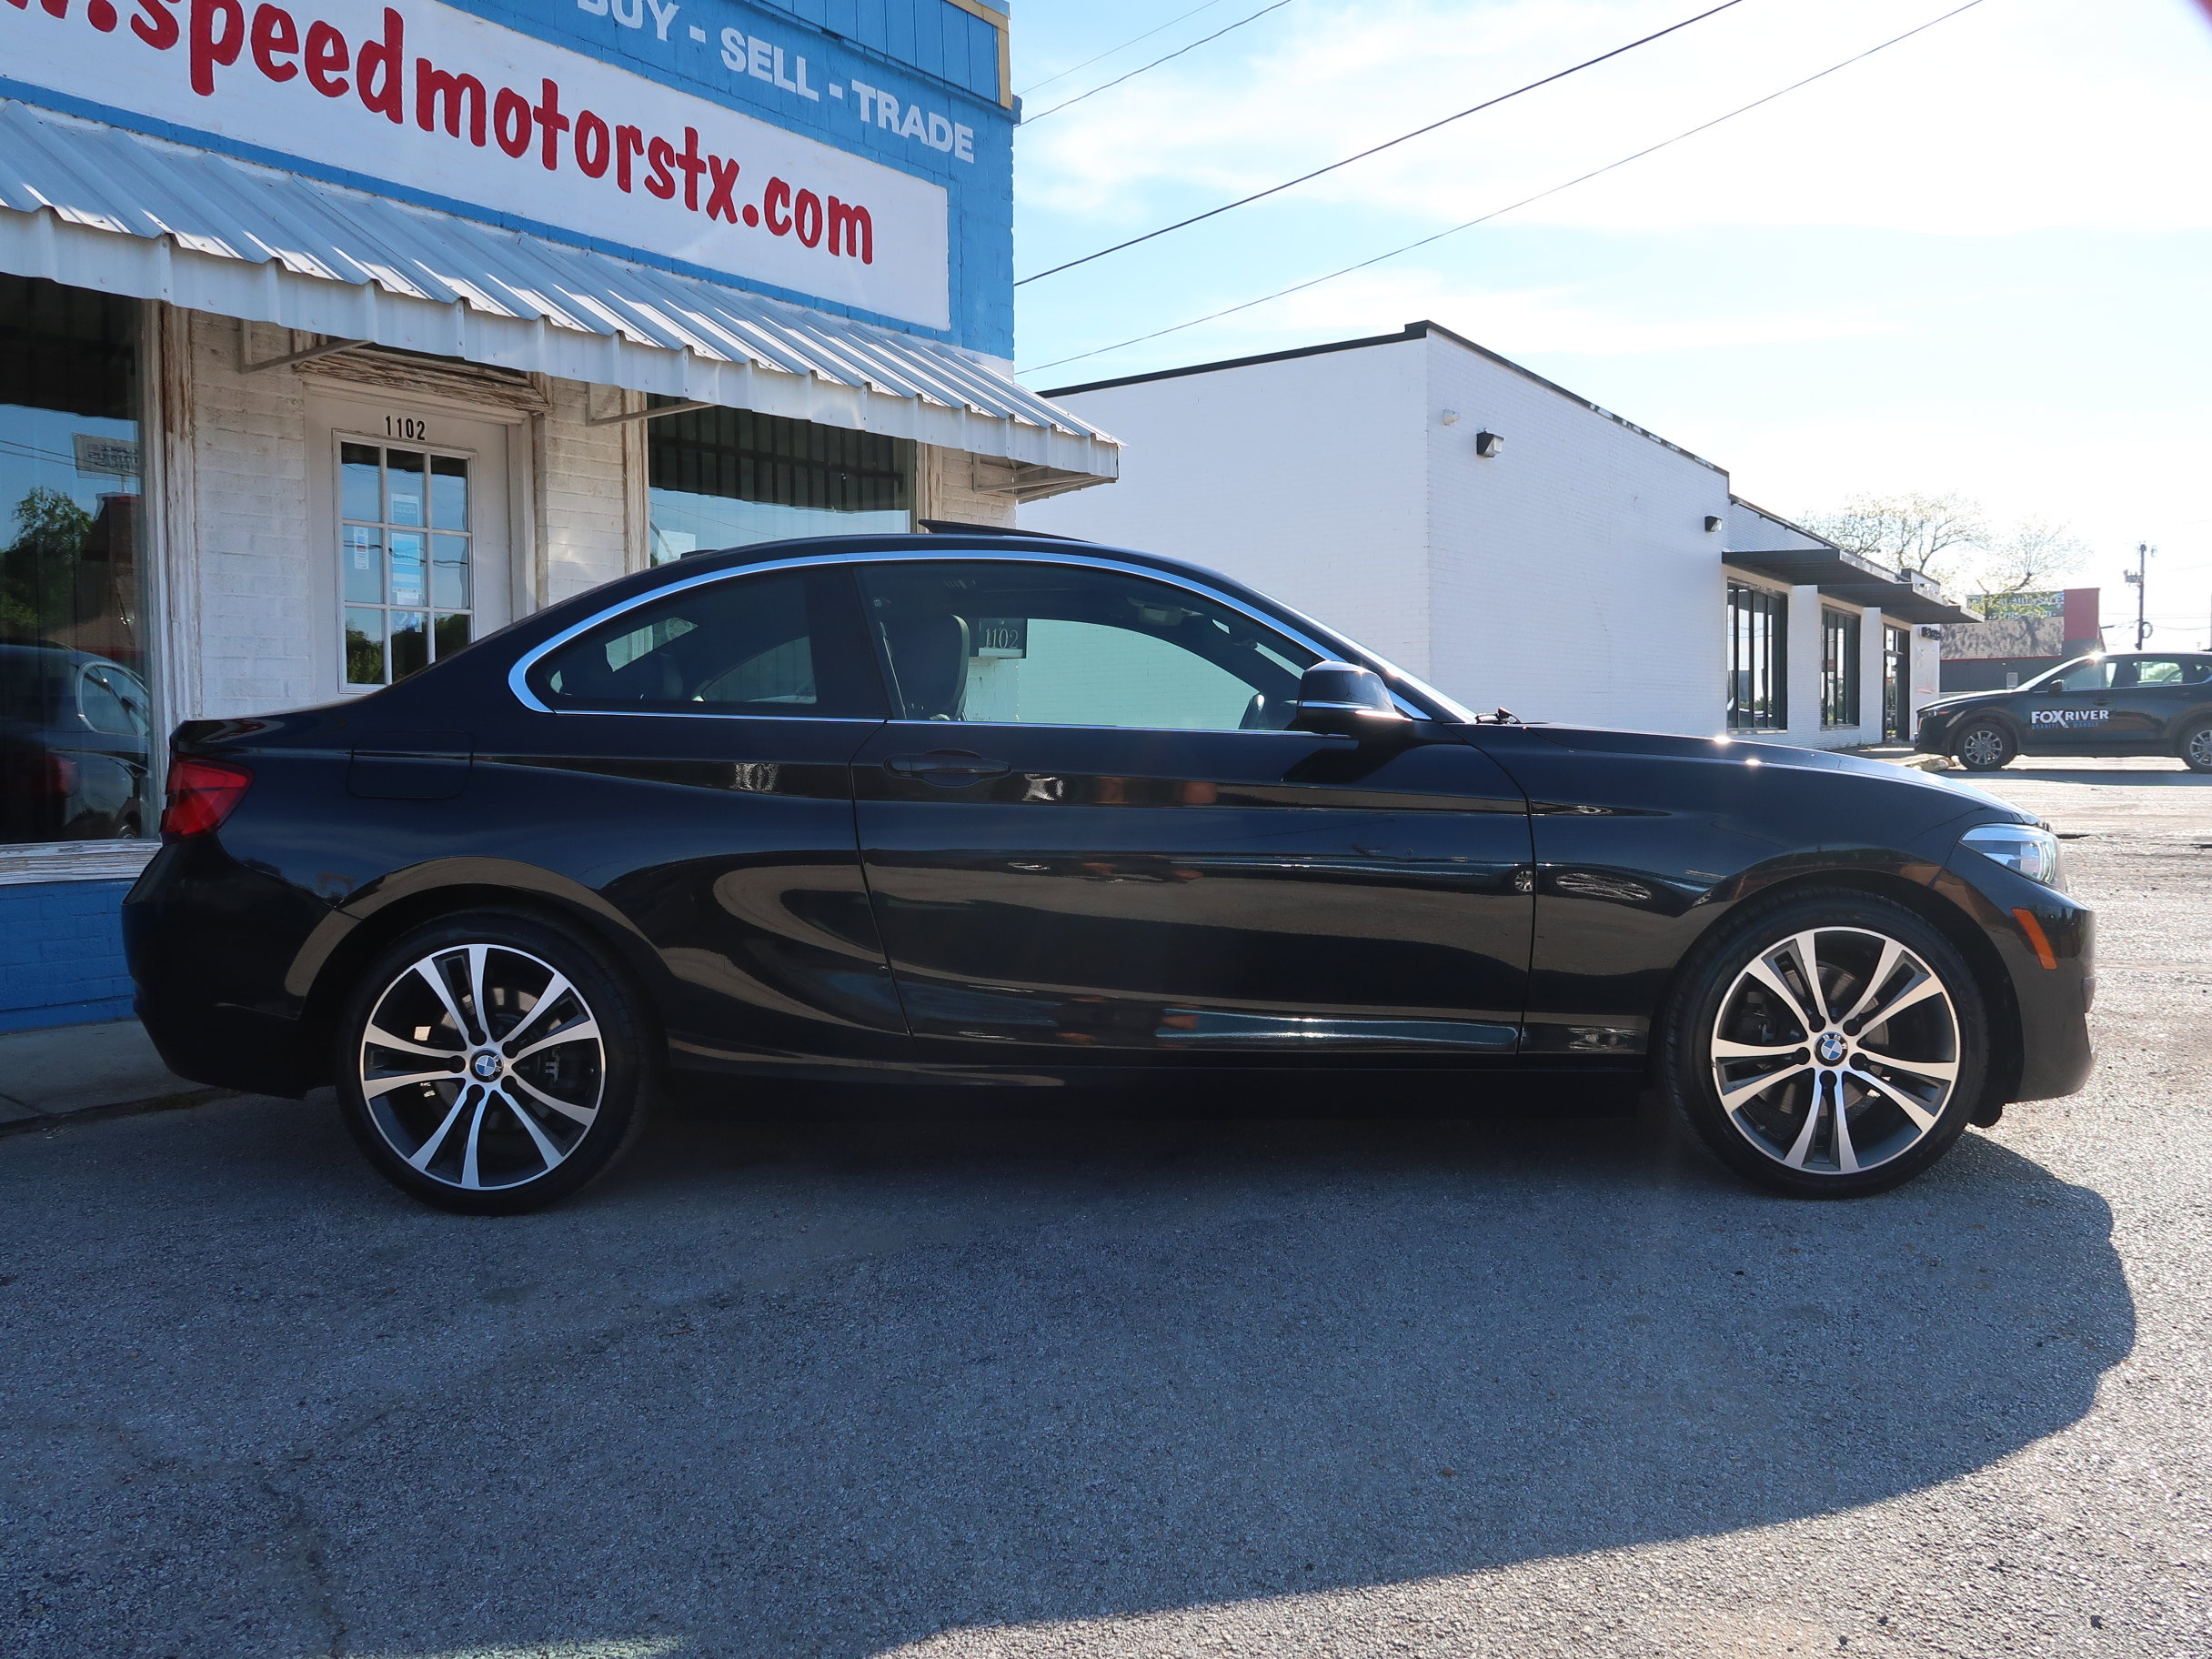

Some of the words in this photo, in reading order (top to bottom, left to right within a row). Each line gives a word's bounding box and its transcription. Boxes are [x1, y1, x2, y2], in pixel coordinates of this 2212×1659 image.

[5, 0, 873, 265] .speedmotorstx.com
[720, 27, 819, 102] SELL
[851, 78, 974, 164] TRADE
[386, 415, 426, 441] 1102
[984, 628, 1019, 649] 1102
